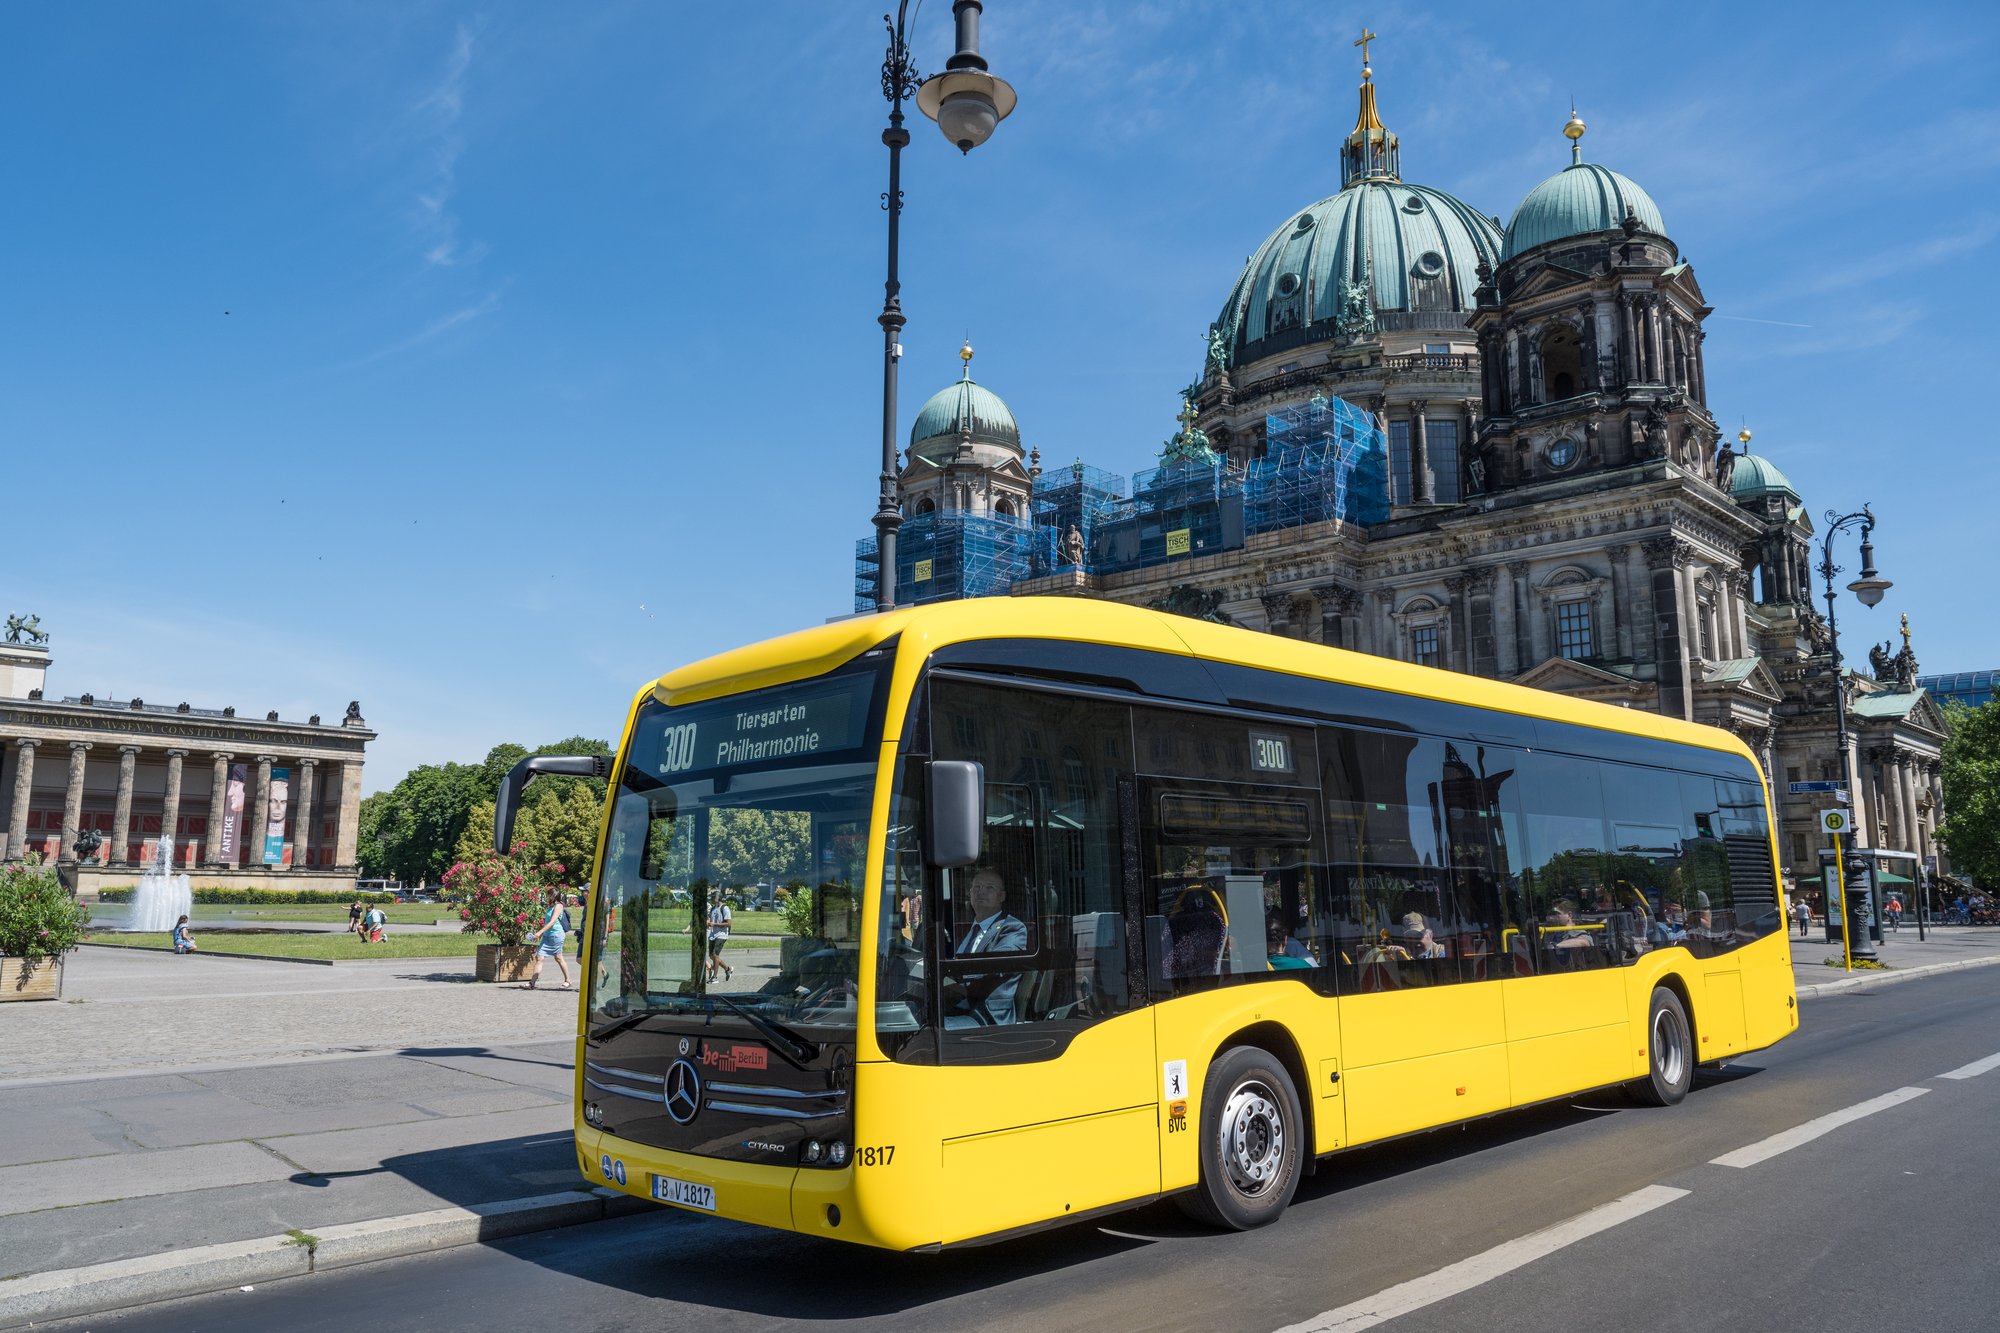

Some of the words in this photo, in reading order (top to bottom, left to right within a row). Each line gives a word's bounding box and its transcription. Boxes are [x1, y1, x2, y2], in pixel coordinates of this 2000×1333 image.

[1168, 535, 1189, 547] TISCH
[736, 704, 806, 731] Tiergarten
[660, 722, 697, 773] 300
[716, 727, 819, 765] Philharmonie
[1257, 738, 1285, 769] 300
[221, 815, 234, 853] ANTIKE
[1829, 816, 1839, 826] H
[703, 1044, 719, 1066] be
[738, 1051, 764, 1066] Berlin
[1168, 1116, 1187, 1133] BVG
[855, 1145, 896, 1167] 1817
[662, 1178, 669, 1197] B
[675, 1181, 682, 1200] V
[684, 1183, 711, 1207] 1817
